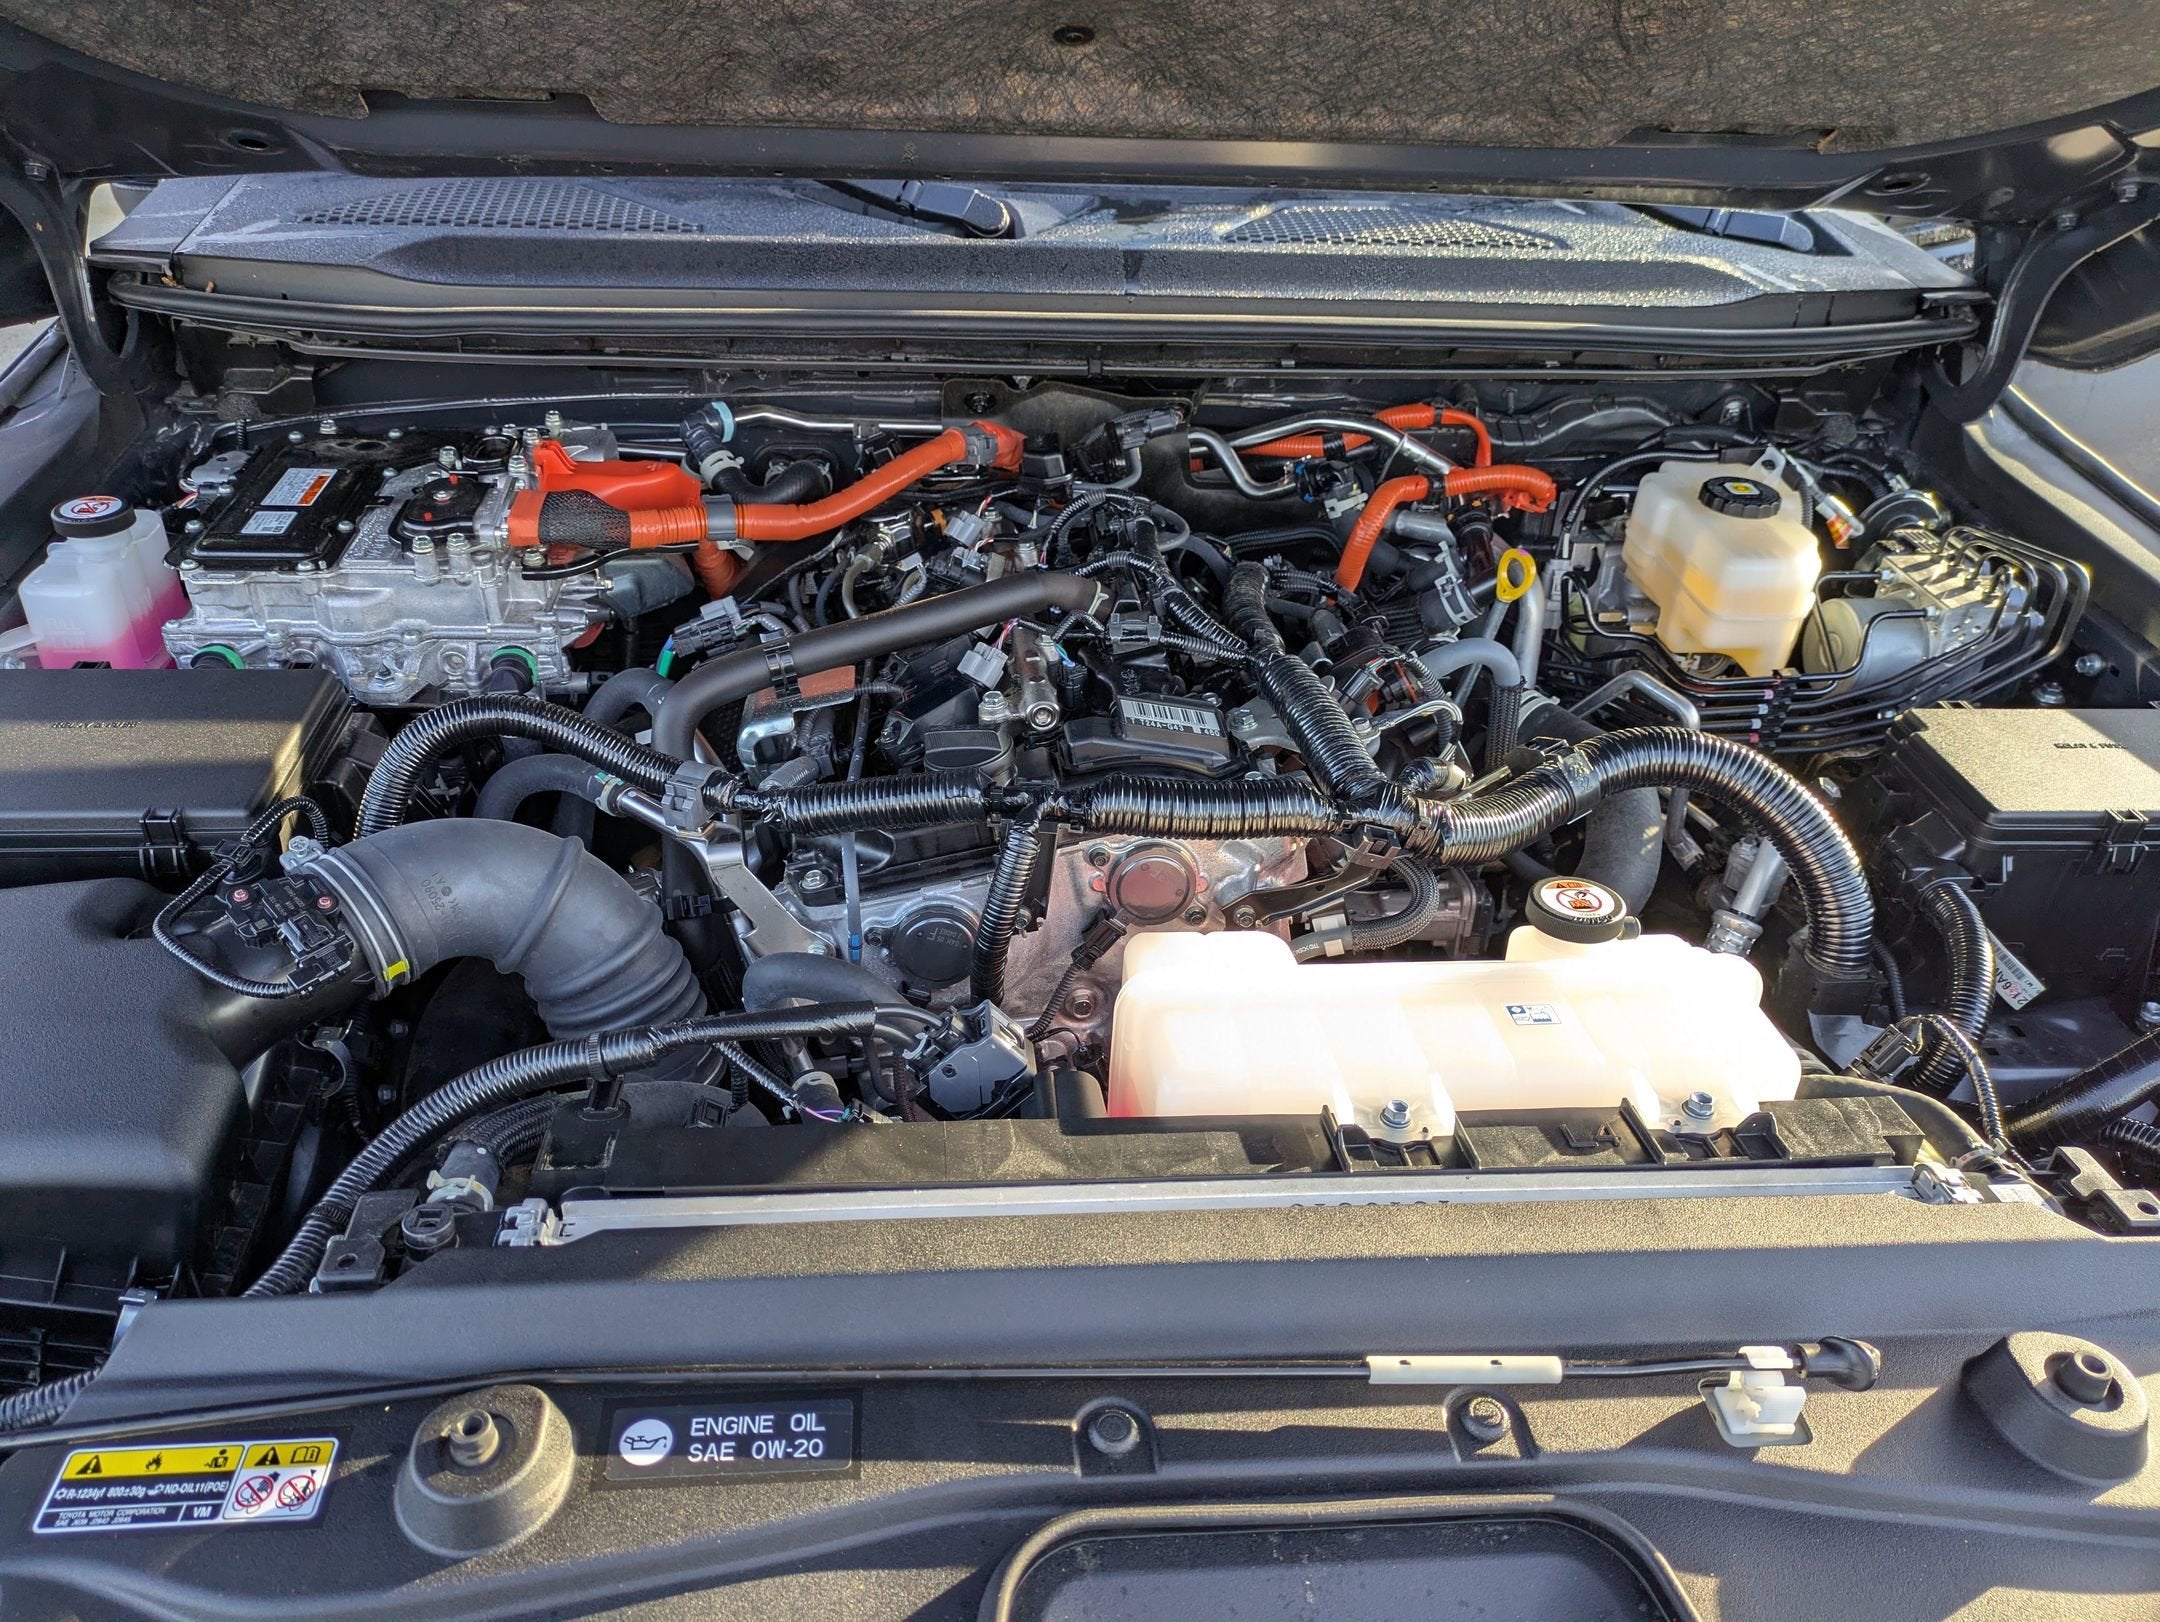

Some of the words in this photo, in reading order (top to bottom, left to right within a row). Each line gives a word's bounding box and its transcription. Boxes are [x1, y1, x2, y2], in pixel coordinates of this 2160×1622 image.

[690, 1415, 774, 1437] ENGINE
[790, 1413, 825, 1432] OIL
[687, 1441, 736, 1463] SAE
[752, 1438, 824, 1459] 0W-20
[165, 1481, 229, 1493] ND-OIL11(POE)
[58, 1511, 86, 1520] TOYOTA
[88, 1509, 115, 1518] MOTOR
[116, 1506, 167, 1516] CORPORATION
[193, 1506, 212, 1518] VM
